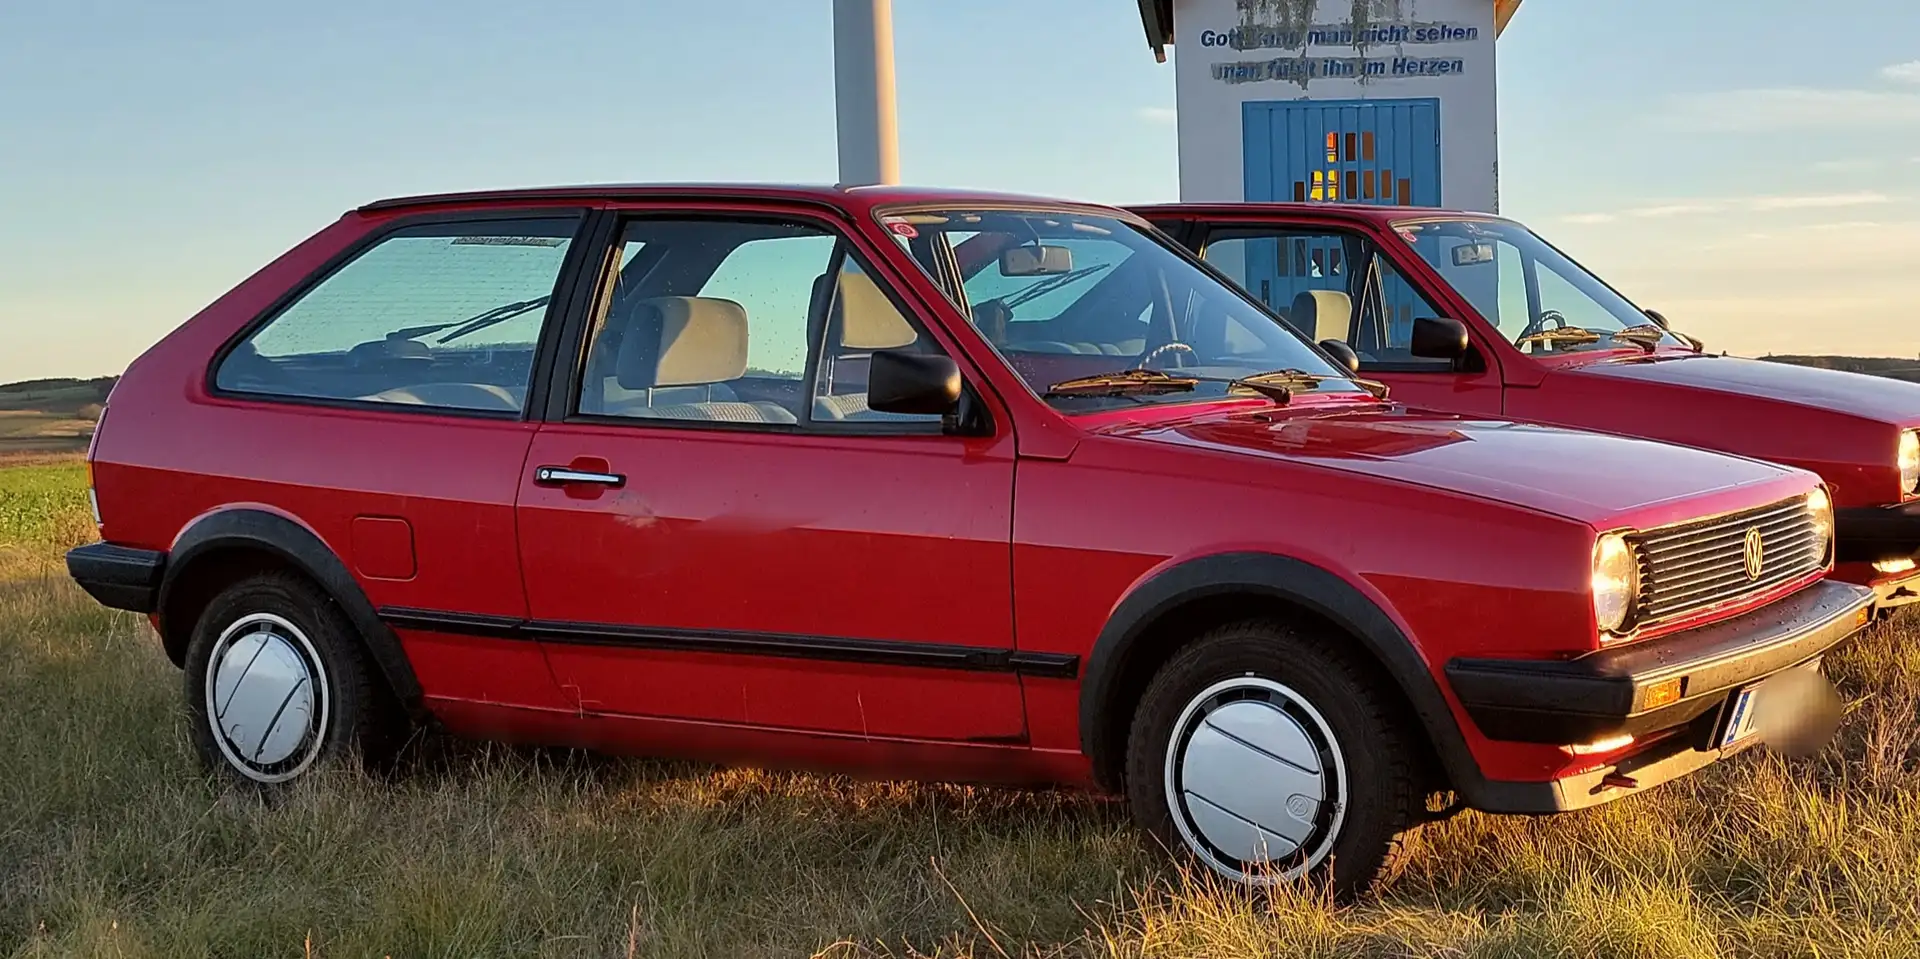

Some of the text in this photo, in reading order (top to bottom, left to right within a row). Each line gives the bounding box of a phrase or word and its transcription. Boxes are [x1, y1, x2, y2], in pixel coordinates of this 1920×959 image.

[1307, 30, 1352, 45] man
[1415, 25, 1478, 40] sehen
[1323, 59, 1354, 76] ihn
[1392, 57, 1463, 74] Herzen
